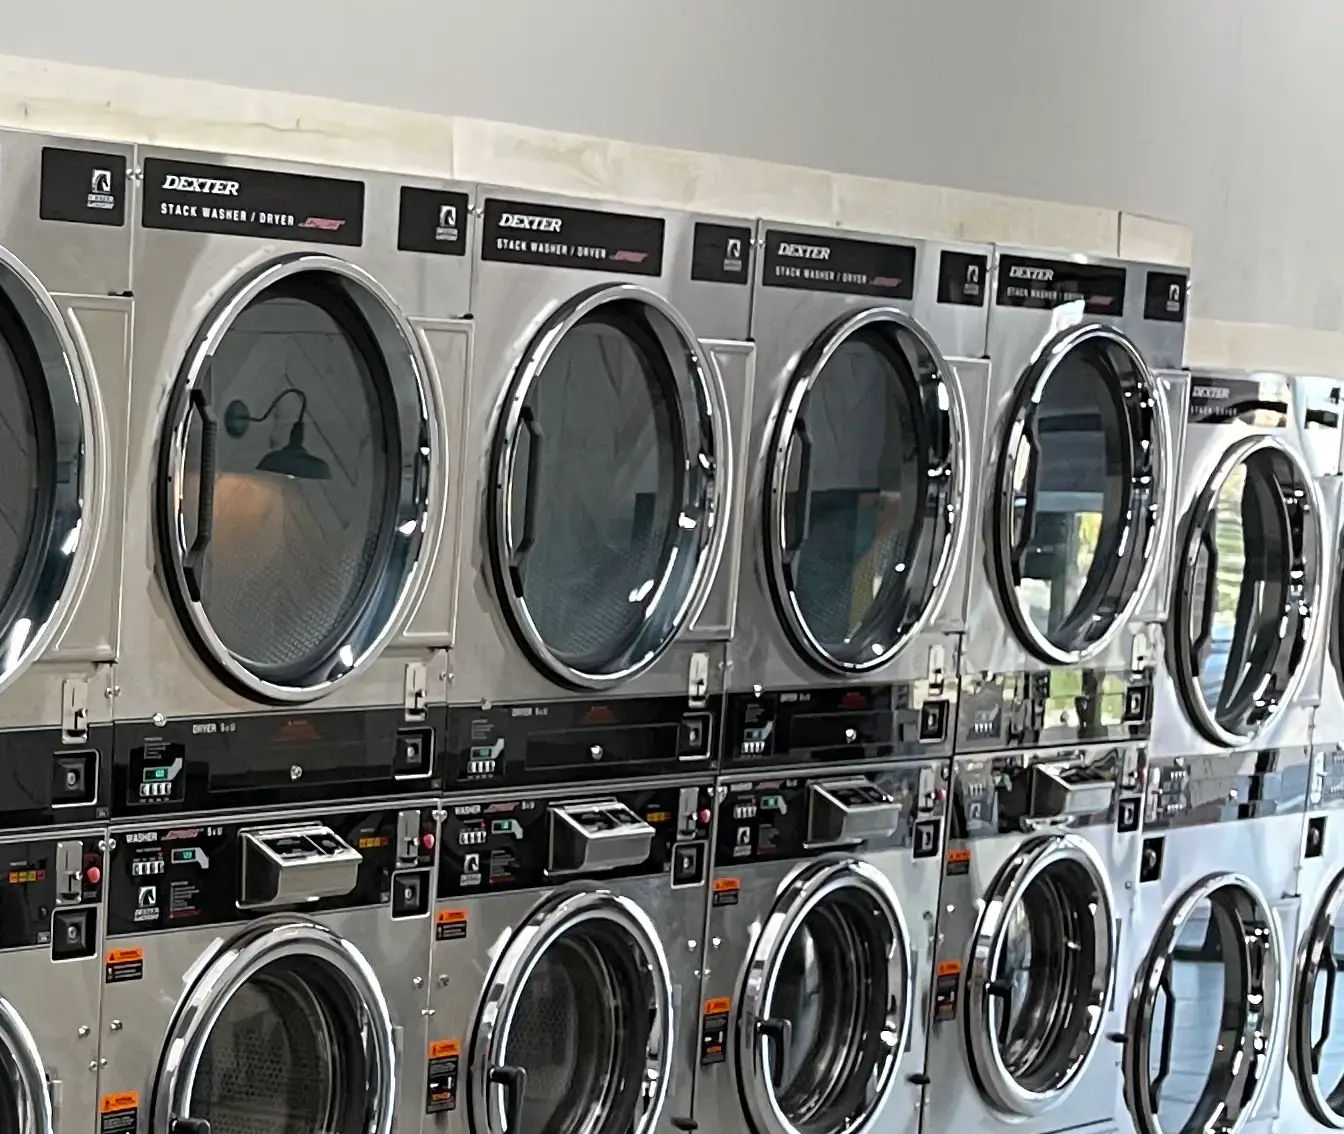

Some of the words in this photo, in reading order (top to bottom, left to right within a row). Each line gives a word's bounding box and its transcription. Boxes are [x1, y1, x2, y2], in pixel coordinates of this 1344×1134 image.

[162, 175, 240, 196] DEXTER
[162, 203, 198, 217] STACK
[202, 208, 246, 222] WASHER
[260, 212, 294, 226] DRYER
[498, 213, 562, 232] DEXTER
[778, 242, 830, 260] DEXTER
[1010, 265, 1054, 280] DEXTER
